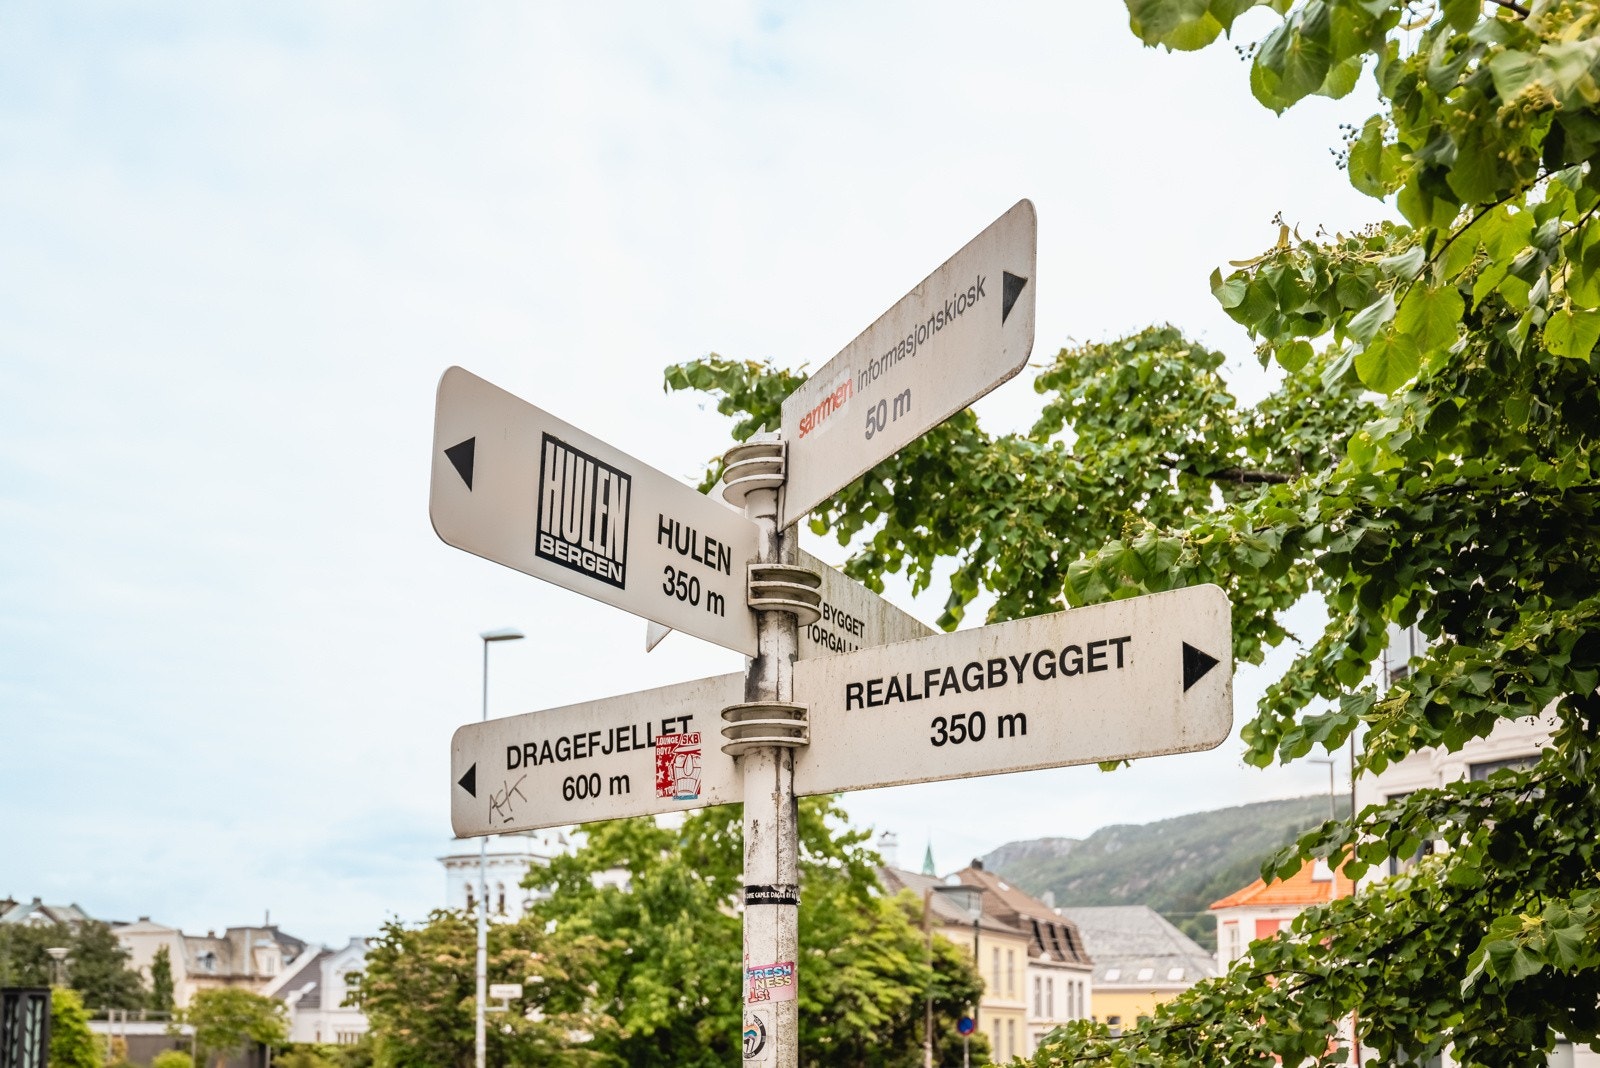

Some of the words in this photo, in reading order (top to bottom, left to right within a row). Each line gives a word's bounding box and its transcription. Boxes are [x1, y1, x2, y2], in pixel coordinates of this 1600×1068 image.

[799, 378, 853, 439] sammen
[857, 274, 986, 393] informasjonskiosk
[865, 399, 887, 440] 50
[893, 388, 911, 422] m
[541, 440, 628, 564] HULEN
[540, 533, 623, 583] BERGEN
[657, 513, 731, 576] HULEN
[662, 565, 700, 606] 350
[706, 588, 725, 617] m
[807, 624, 860, 653] TORGA
[823, 602, 865, 638] BYGGET
[846, 636, 1131, 711] REALFAGBYGGET
[507, 714, 693, 770] DRAGEFJELLET
[682, 733, 699, 744] SKB
[930, 711, 986, 747] 350
[998, 711, 1027, 739] m
[562, 772, 602, 801] 600
[609, 774, 630, 796] m
[746, 965, 792, 980] FRESH
[755, 975, 792, 990] NESS
[748, 987, 770, 1003] 1st
